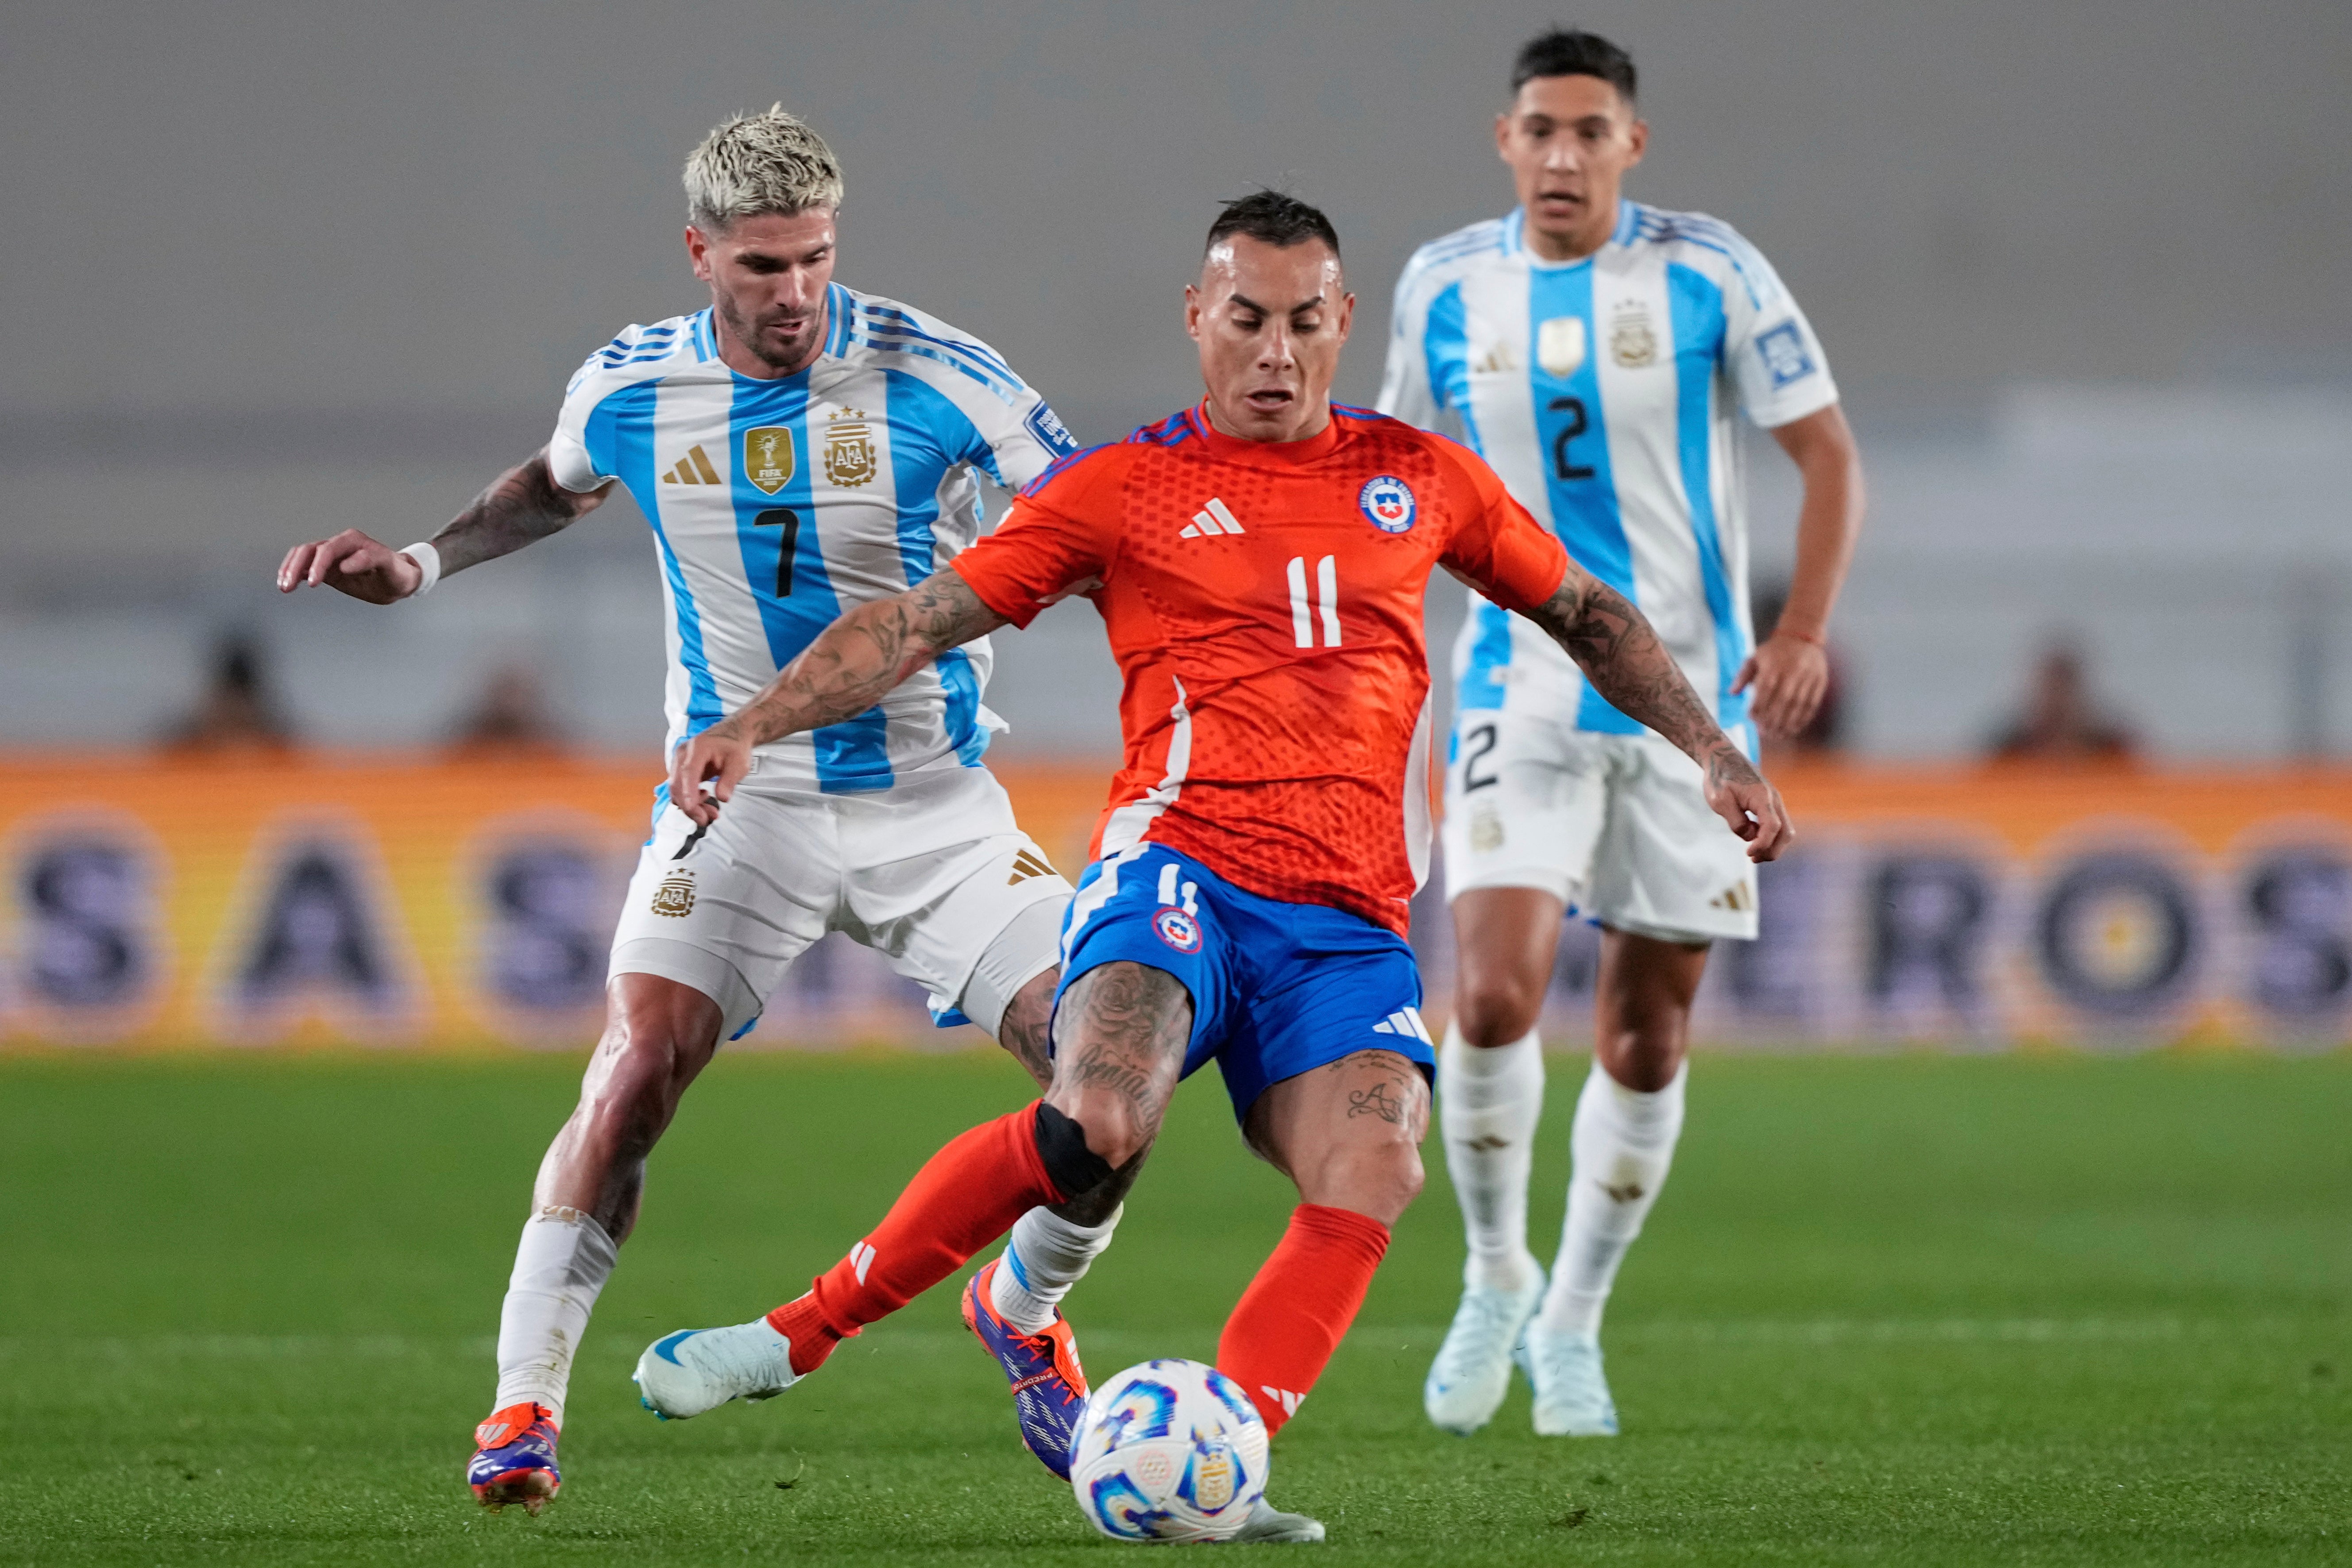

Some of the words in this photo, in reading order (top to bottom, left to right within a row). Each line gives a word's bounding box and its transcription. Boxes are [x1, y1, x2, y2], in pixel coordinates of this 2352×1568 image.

[835, 440, 866, 470] AFA
[1549, 396, 1595, 480] 2
[753, 508, 799, 598] 7
[1286, 555, 1342, 648] 11
[1463, 723, 1499, 794] 2
[659, 887, 686, 907] AFA
[1157, 863, 1199, 917] 11
